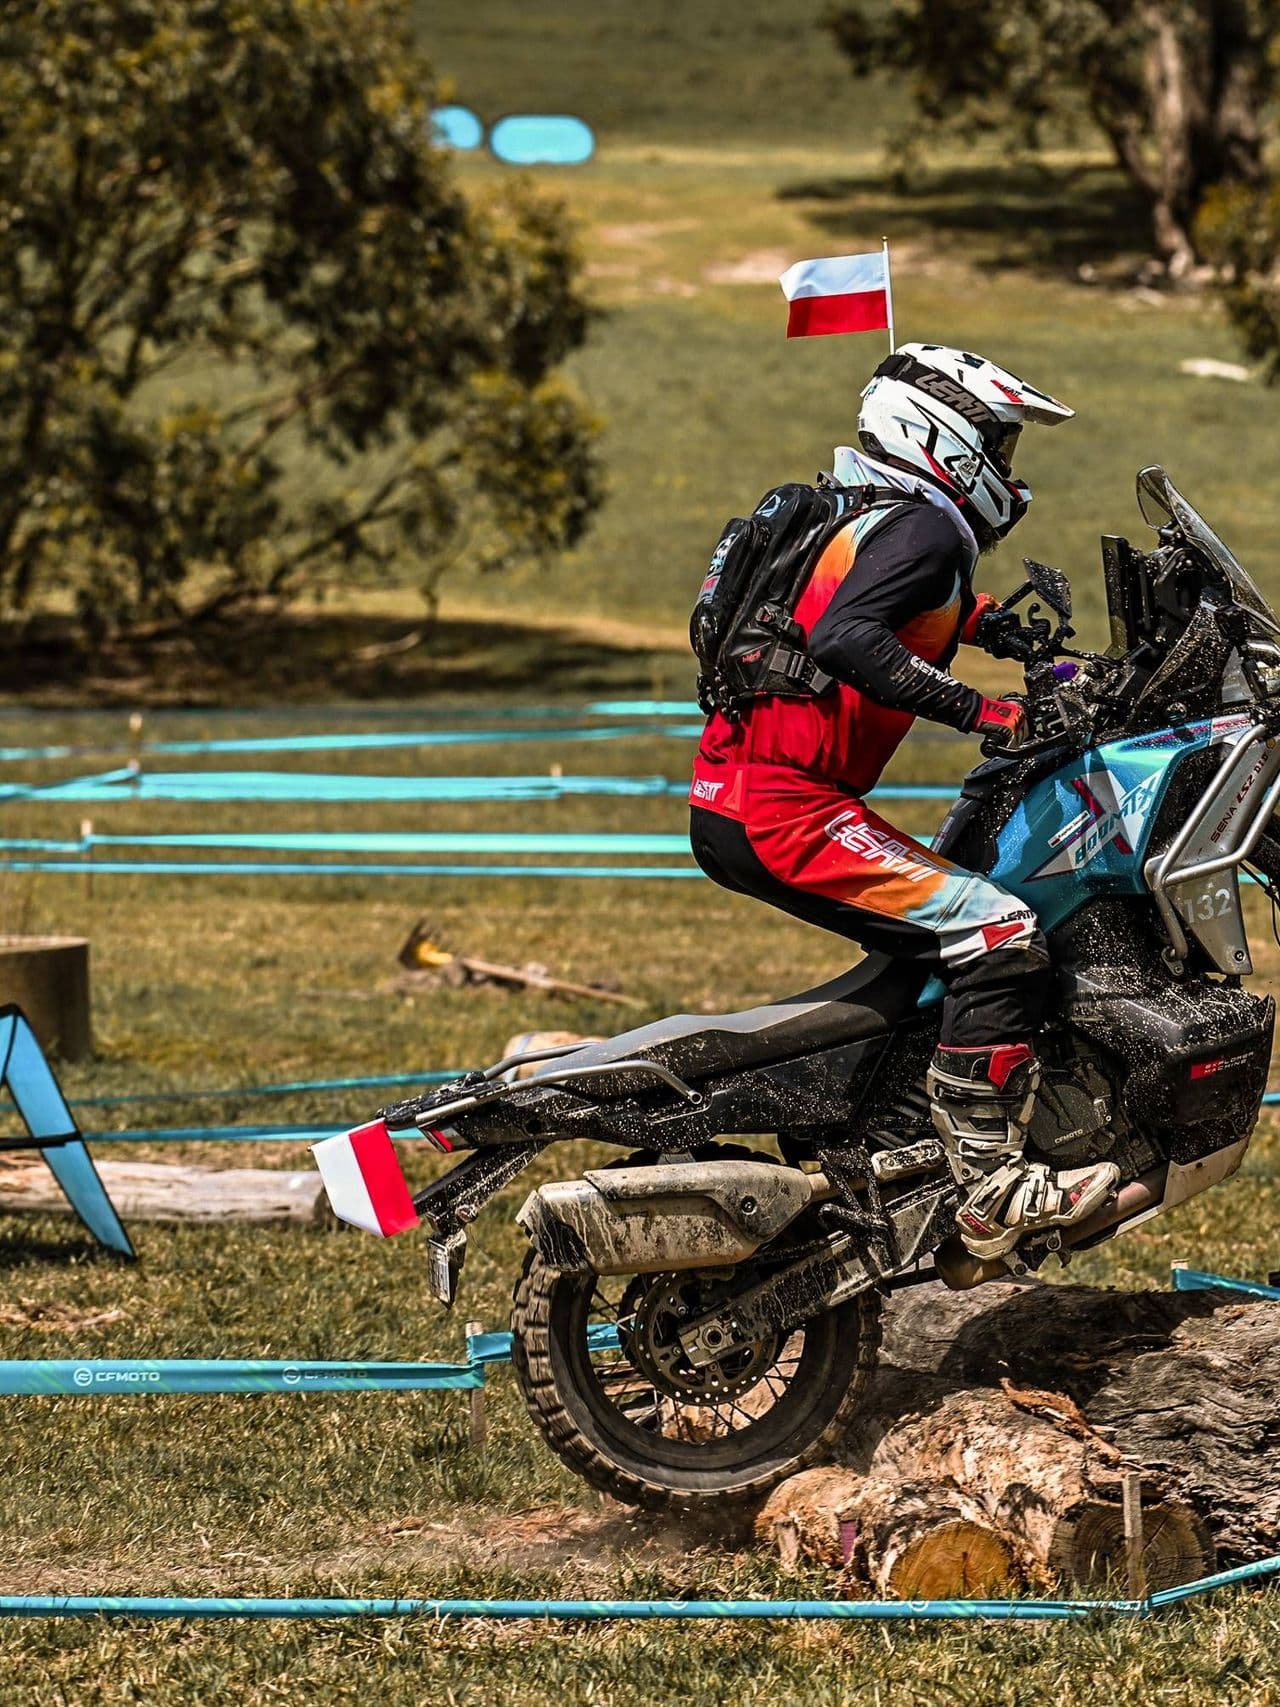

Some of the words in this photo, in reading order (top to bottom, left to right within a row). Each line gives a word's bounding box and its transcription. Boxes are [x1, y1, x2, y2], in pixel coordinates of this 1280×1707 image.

[915, 373, 998, 423] LEATT
[693, 778, 725, 802] LEATT
[1210, 806, 1237, 843] SENA
[1236, 774, 1256, 804] LS2
[824, 810, 948, 883] LEATT
[1183, 888, 1232, 923] 132
[1204, 1051, 1254, 1070] EXPLORER
[1204, 1059, 1247, 1073] MACHINE
[1055, 1129, 1083, 1144] CFMOTO
[96, 1372, 160, 1382] CFMOTO
[304, 1369, 368, 1380] CFMOTO
